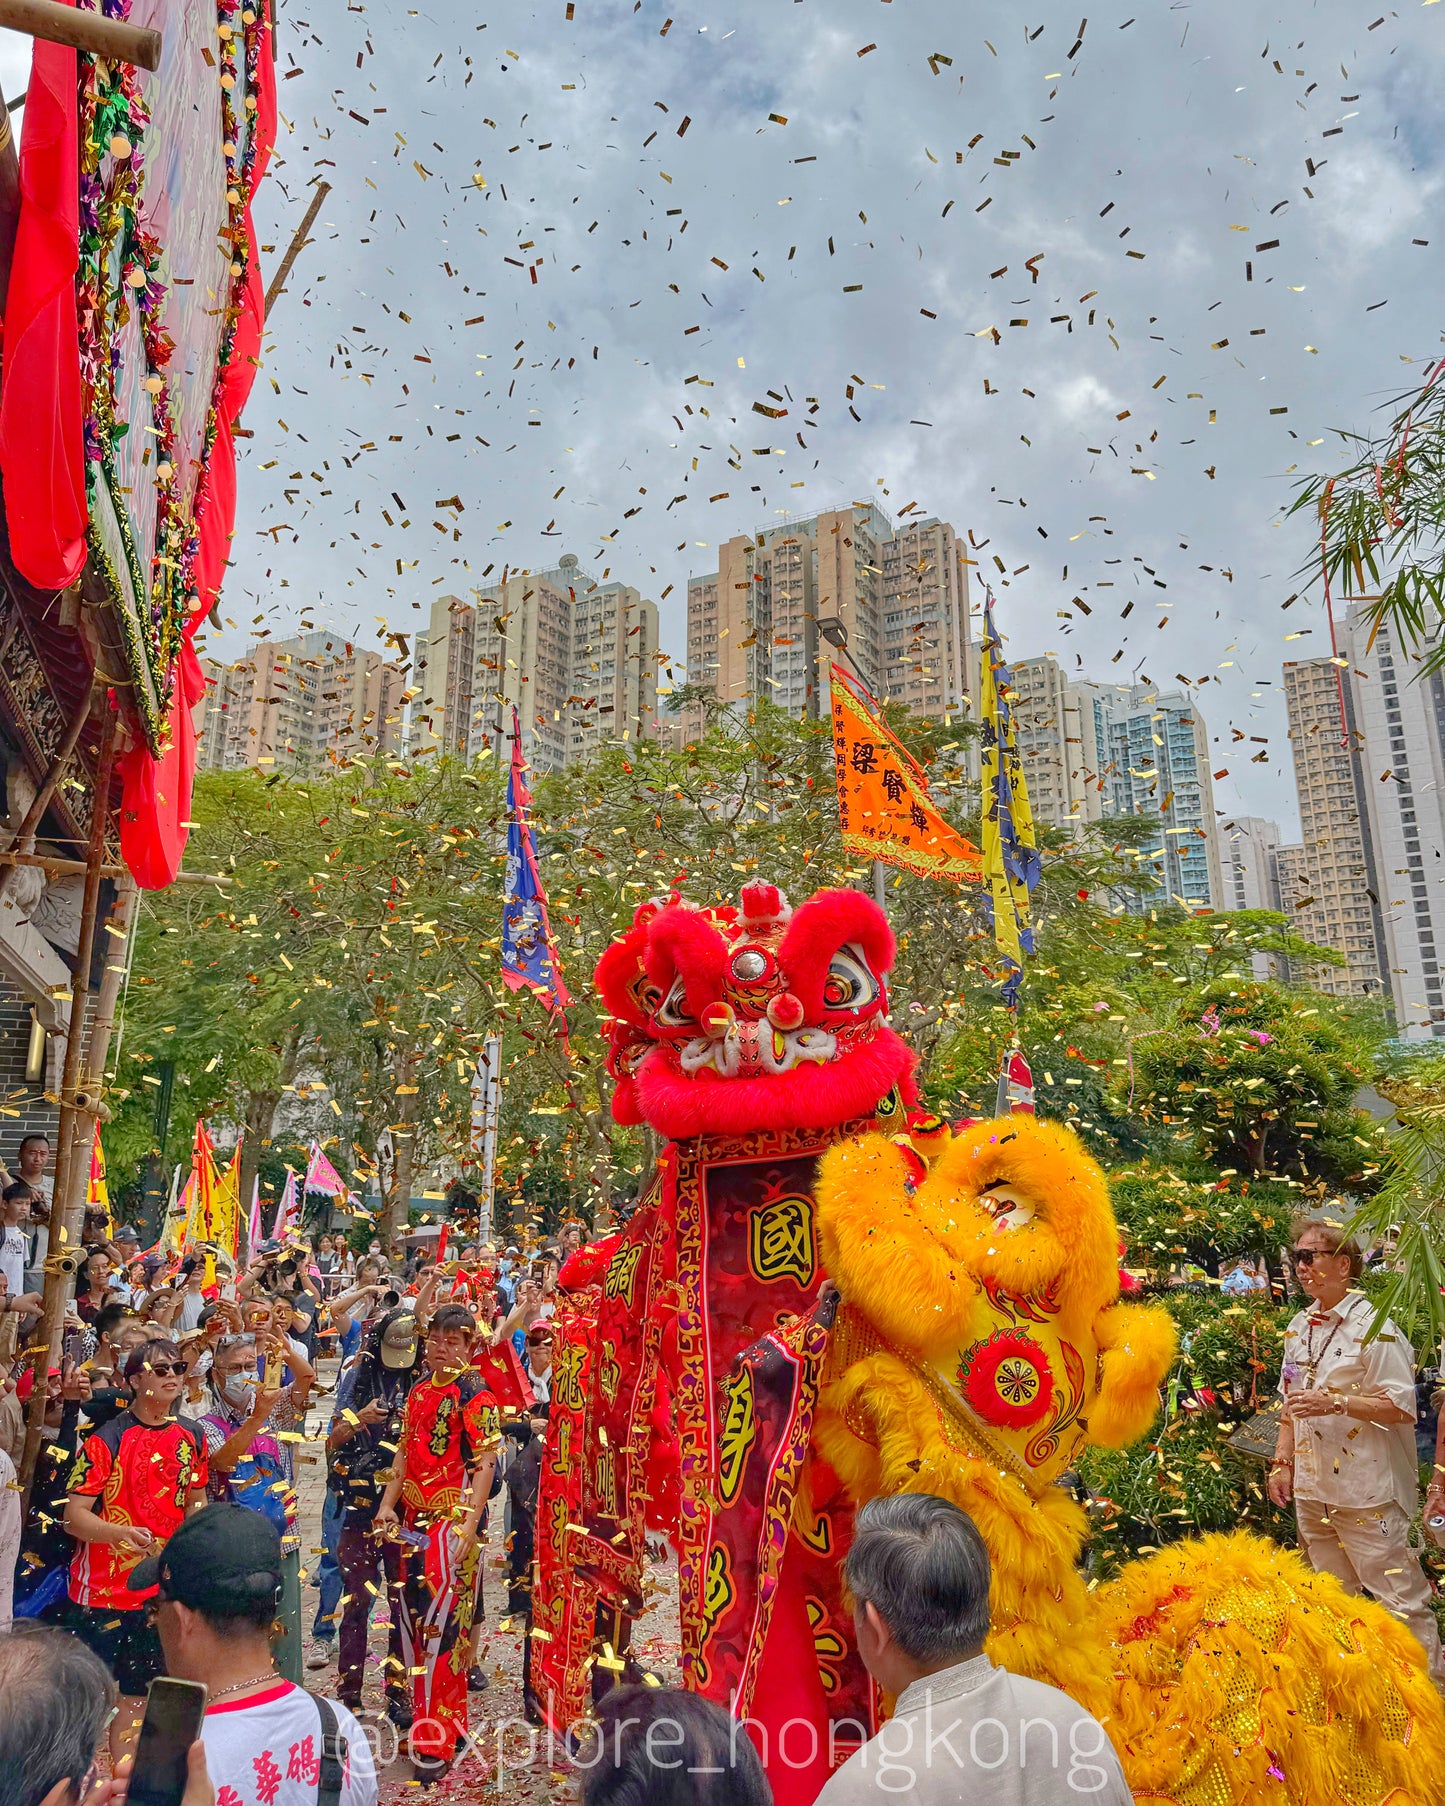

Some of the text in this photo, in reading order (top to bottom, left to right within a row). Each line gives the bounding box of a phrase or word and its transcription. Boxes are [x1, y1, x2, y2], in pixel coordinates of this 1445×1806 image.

[850, 742, 930, 836] 梁賢輝
[752, 1199, 813, 1285] 國
